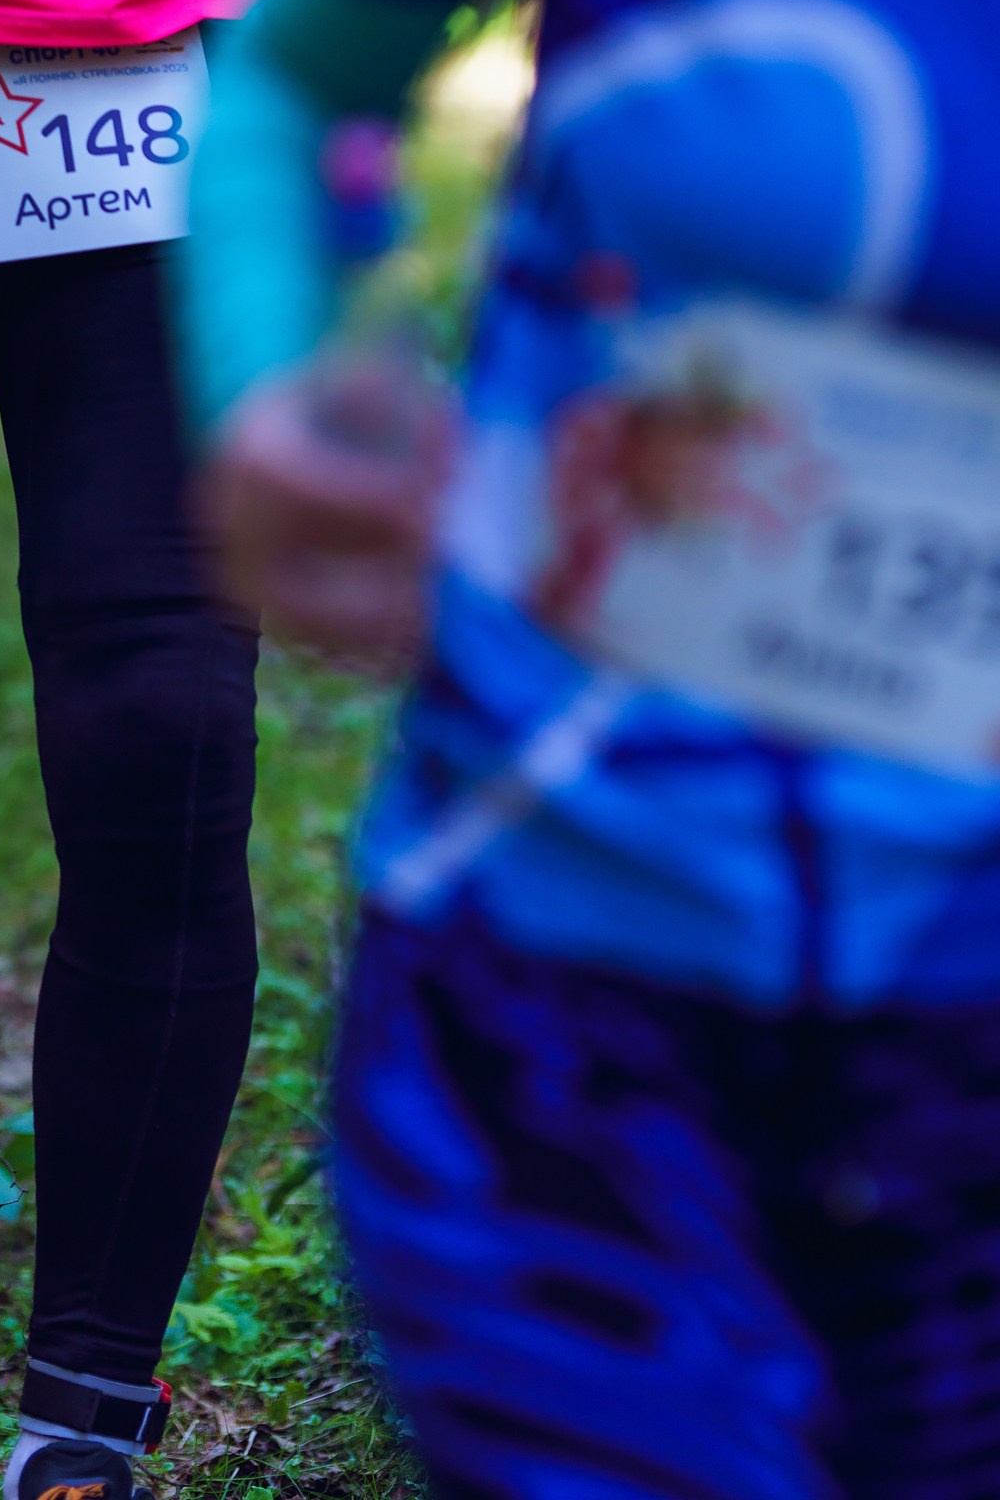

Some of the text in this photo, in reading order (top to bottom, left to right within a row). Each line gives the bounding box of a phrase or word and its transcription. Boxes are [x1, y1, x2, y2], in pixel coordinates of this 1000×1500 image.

[161, 63, 189, 73] 2025
[41, 104, 190, 174] 148
[15, 186, 152, 230] Артем
